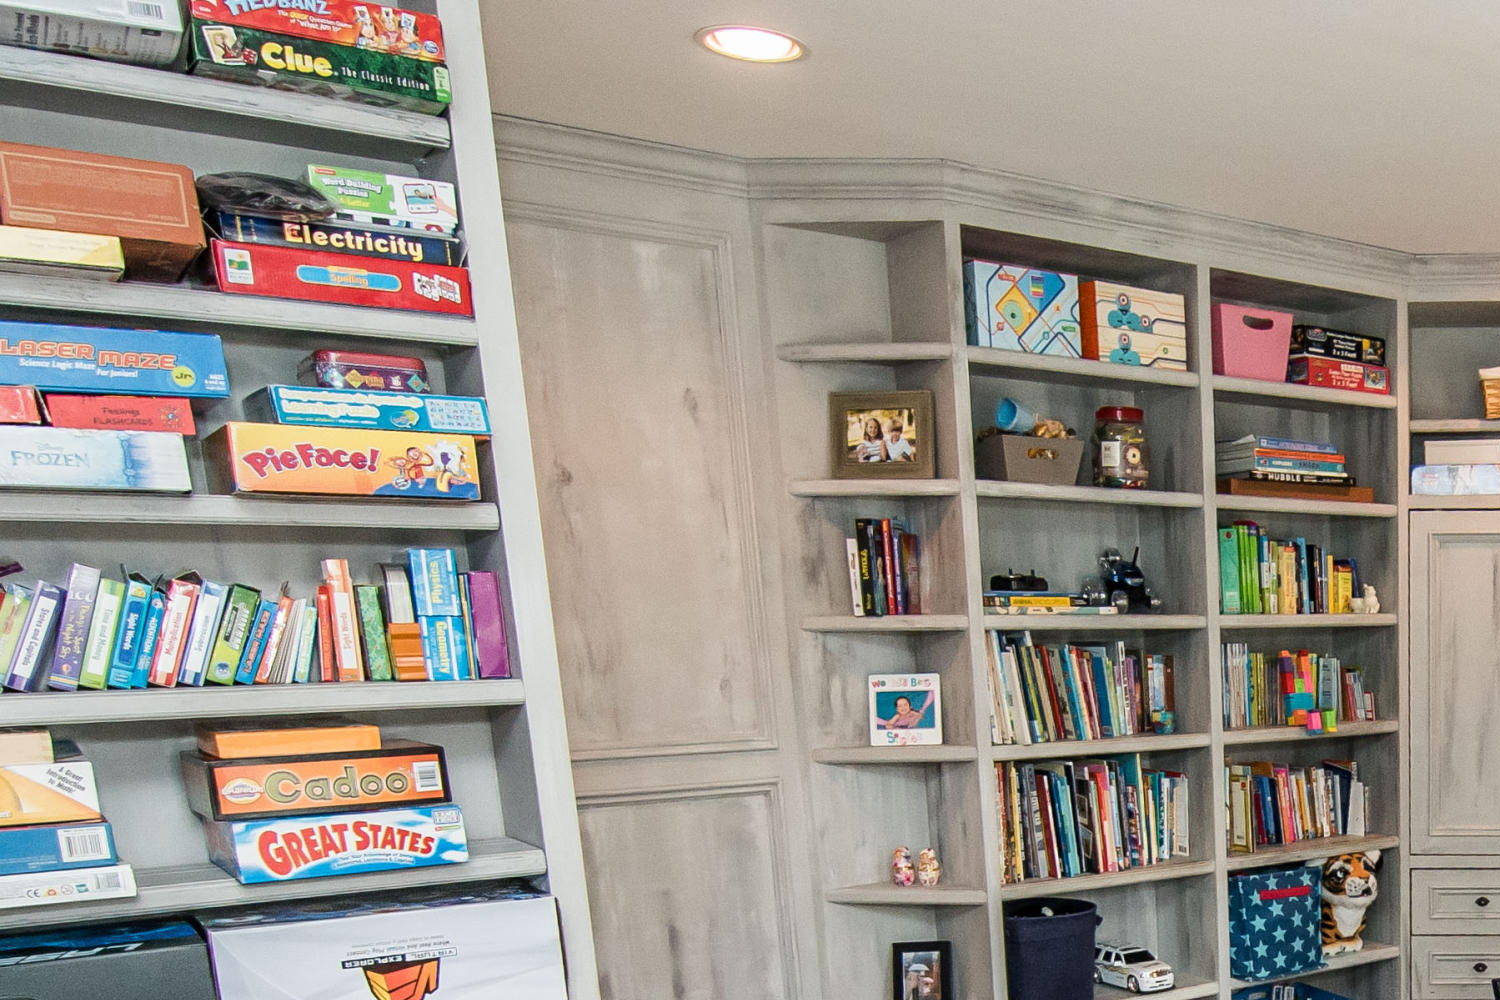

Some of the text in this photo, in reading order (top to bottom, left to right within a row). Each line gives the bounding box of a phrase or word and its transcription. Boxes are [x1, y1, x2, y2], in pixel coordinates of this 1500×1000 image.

[260, 41, 334, 78] Clue
[341, 66, 431, 92] The Classic Edition
[283, 222, 424, 262] Electricity
[0, 338, 178, 370] LASER MAZE
[19, 357, 50, 369] Science
[10, 450, 91, 469] FROZEN
[1267, 472, 1301, 483] HUBBLE
[429, 560, 444, 604] Physics
[123, 612, 140, 651] Sight Words
[435, 620, 451, 674] Geometry
[265, 766, 409, 803] Cadoo
[257, 821, 436, 876] GREAT STATES
[344, 954, 404, 968] EXPLORER
